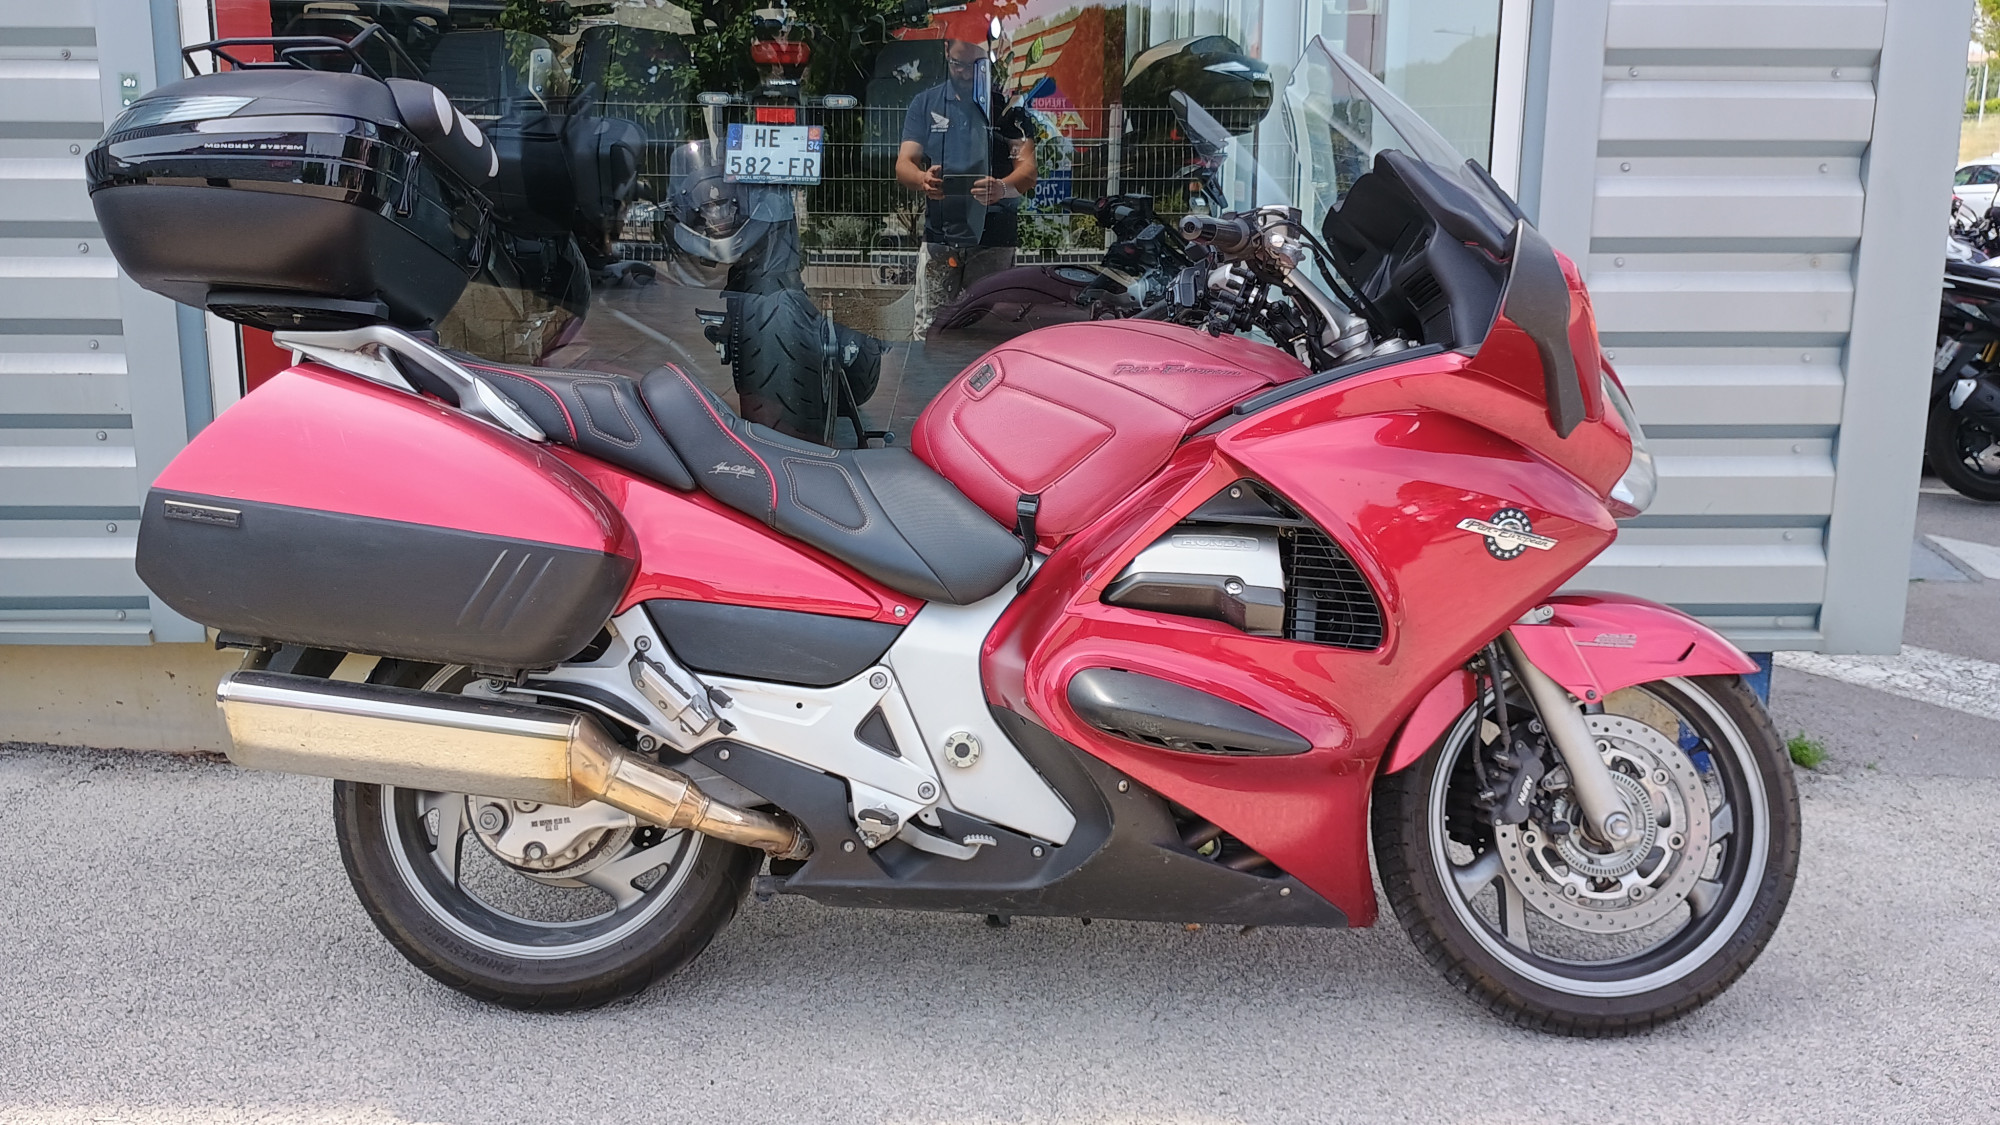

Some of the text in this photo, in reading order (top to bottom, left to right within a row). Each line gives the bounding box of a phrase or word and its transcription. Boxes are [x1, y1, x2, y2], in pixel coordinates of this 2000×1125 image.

[755, 129, 780, 147] HE
[807, 141, 820, 151] 34
[1181, 538, 1252, 548] HONDA
